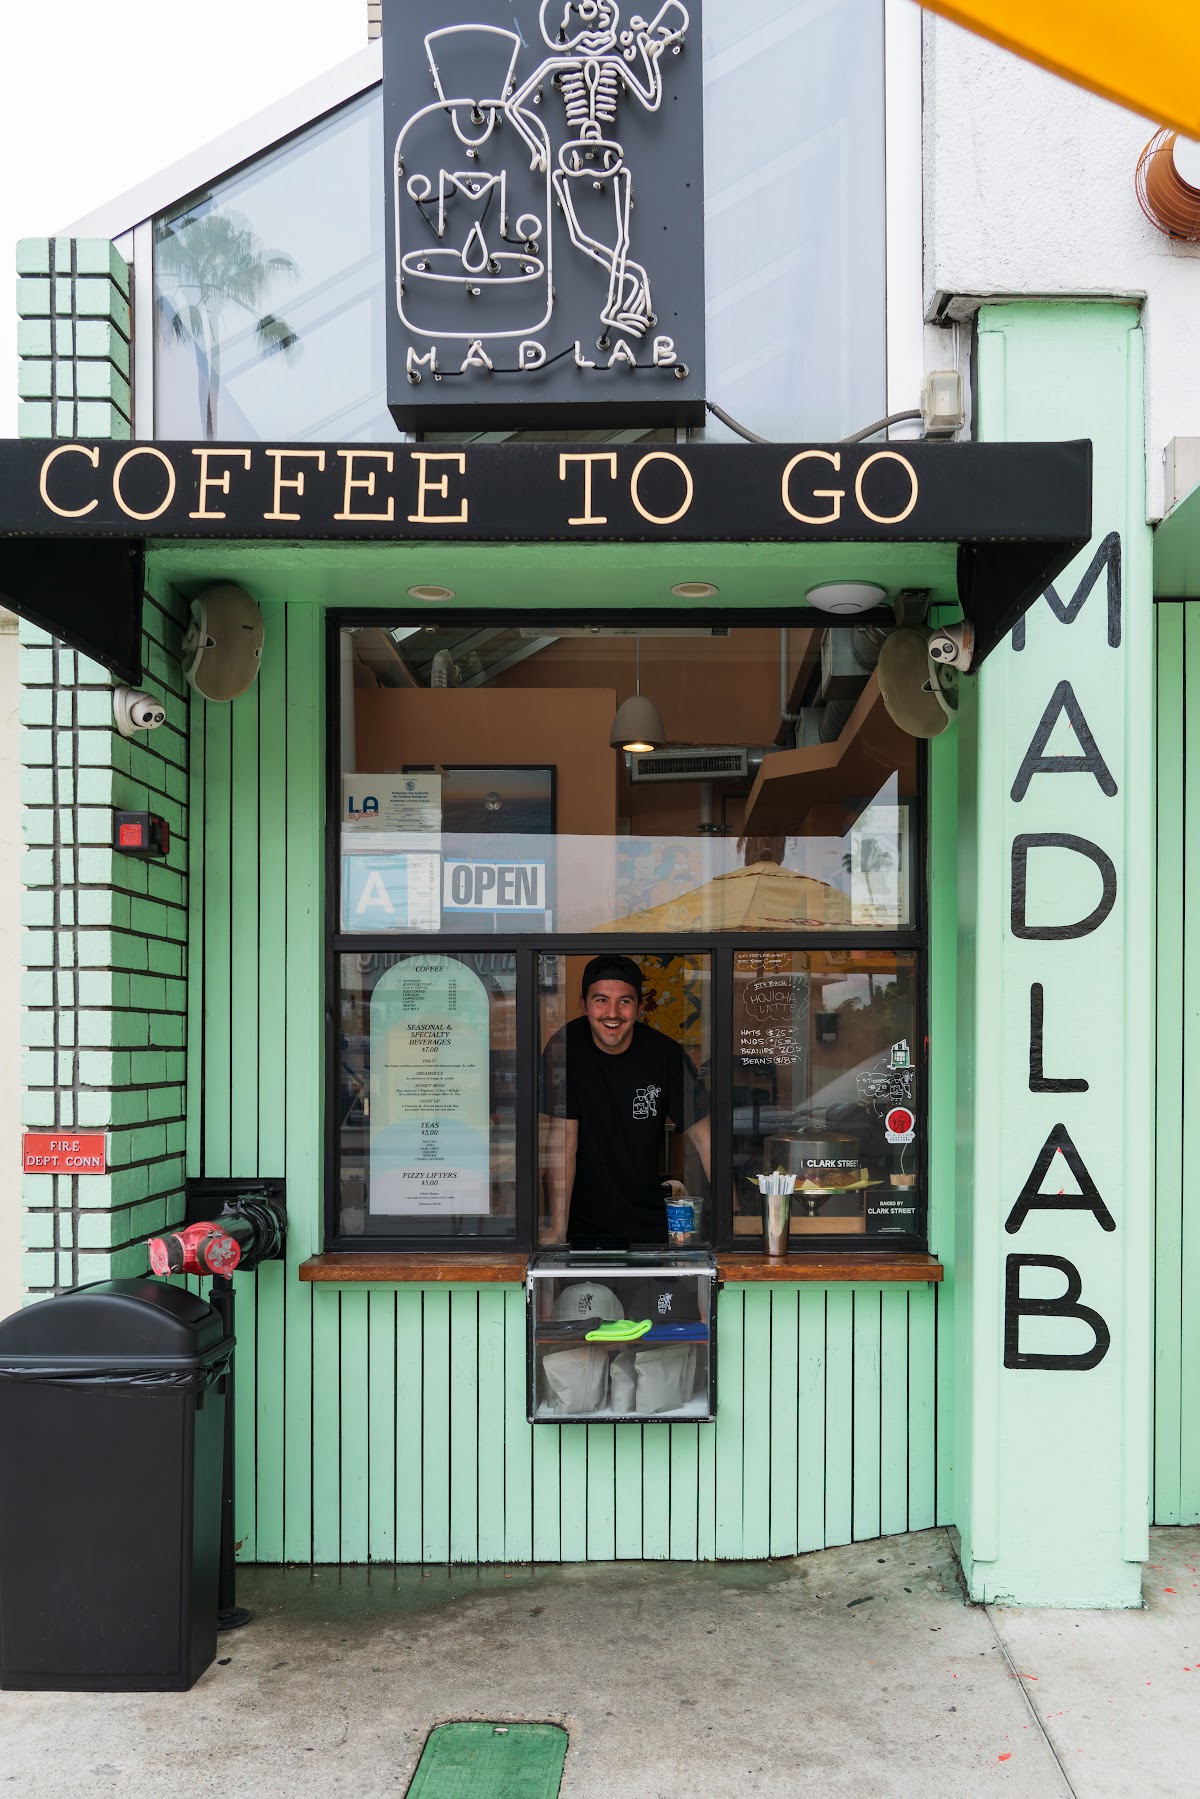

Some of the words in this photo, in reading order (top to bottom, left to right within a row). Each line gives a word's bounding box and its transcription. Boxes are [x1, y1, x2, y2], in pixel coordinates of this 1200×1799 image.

[39, 444, 468, 523] COFFEE
[558, 451, 694, 525] TO
[781, 449, 919, 525] GO
[348, 796, 379, 814] LA
[451, 864, 538, 906] OPEN
[355, 872, 396, 914] A
[750, 990, 797, 1005] HOJICHA
[759, 1003, 797, 1013] LATTE
[740, 1046, 774, 1054] BEANIES
[50, 1141, 80, 1151] FIRE
[27, 1156, 60, 1166] DEPT.
[65, 1156, 103, 1167] CONN.
